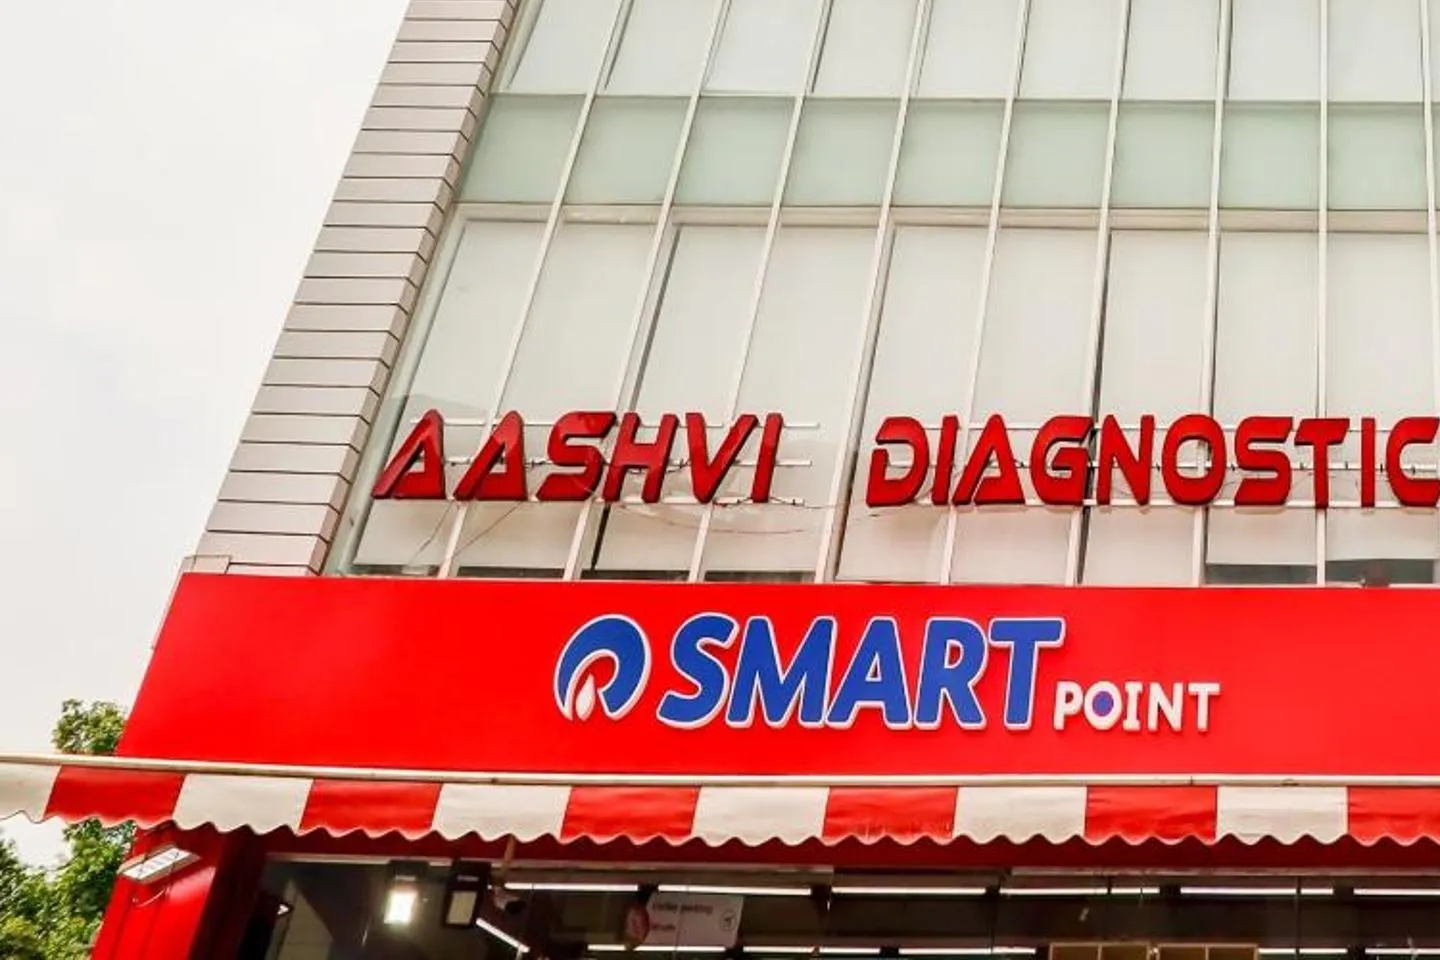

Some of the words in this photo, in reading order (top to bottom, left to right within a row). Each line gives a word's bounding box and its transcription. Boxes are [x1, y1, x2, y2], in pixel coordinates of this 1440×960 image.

[372, 408, 784, 504] AASHVI
[656, 612, 1067, 733] SMART
[1053, 681, 1221, 733] POINT
